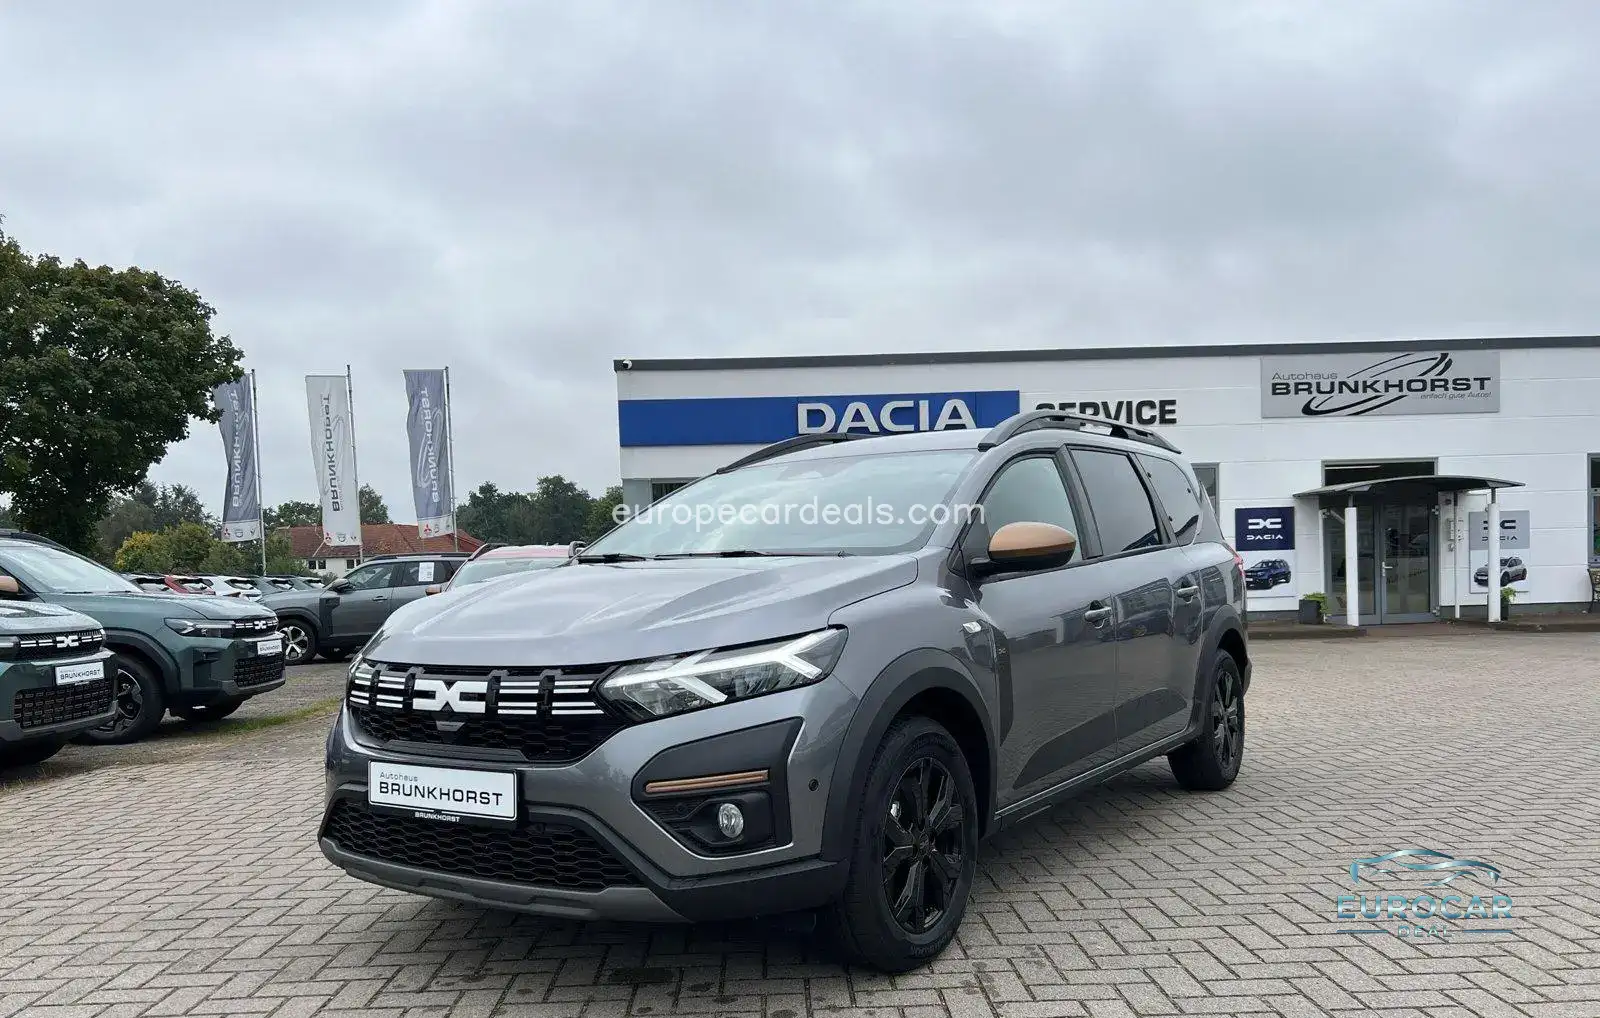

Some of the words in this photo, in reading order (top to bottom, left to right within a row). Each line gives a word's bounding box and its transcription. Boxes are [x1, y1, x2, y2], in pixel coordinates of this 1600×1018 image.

[1271, 372, 1337, 381] Autohaus
[1271, 377, 1491, 396] BRUNKHORST
[796, 399, 977, 434] DACIA
[379, 782, 503, 806] BRUNKHORST
[415, 811, 460, 823] BRUNKHORST
